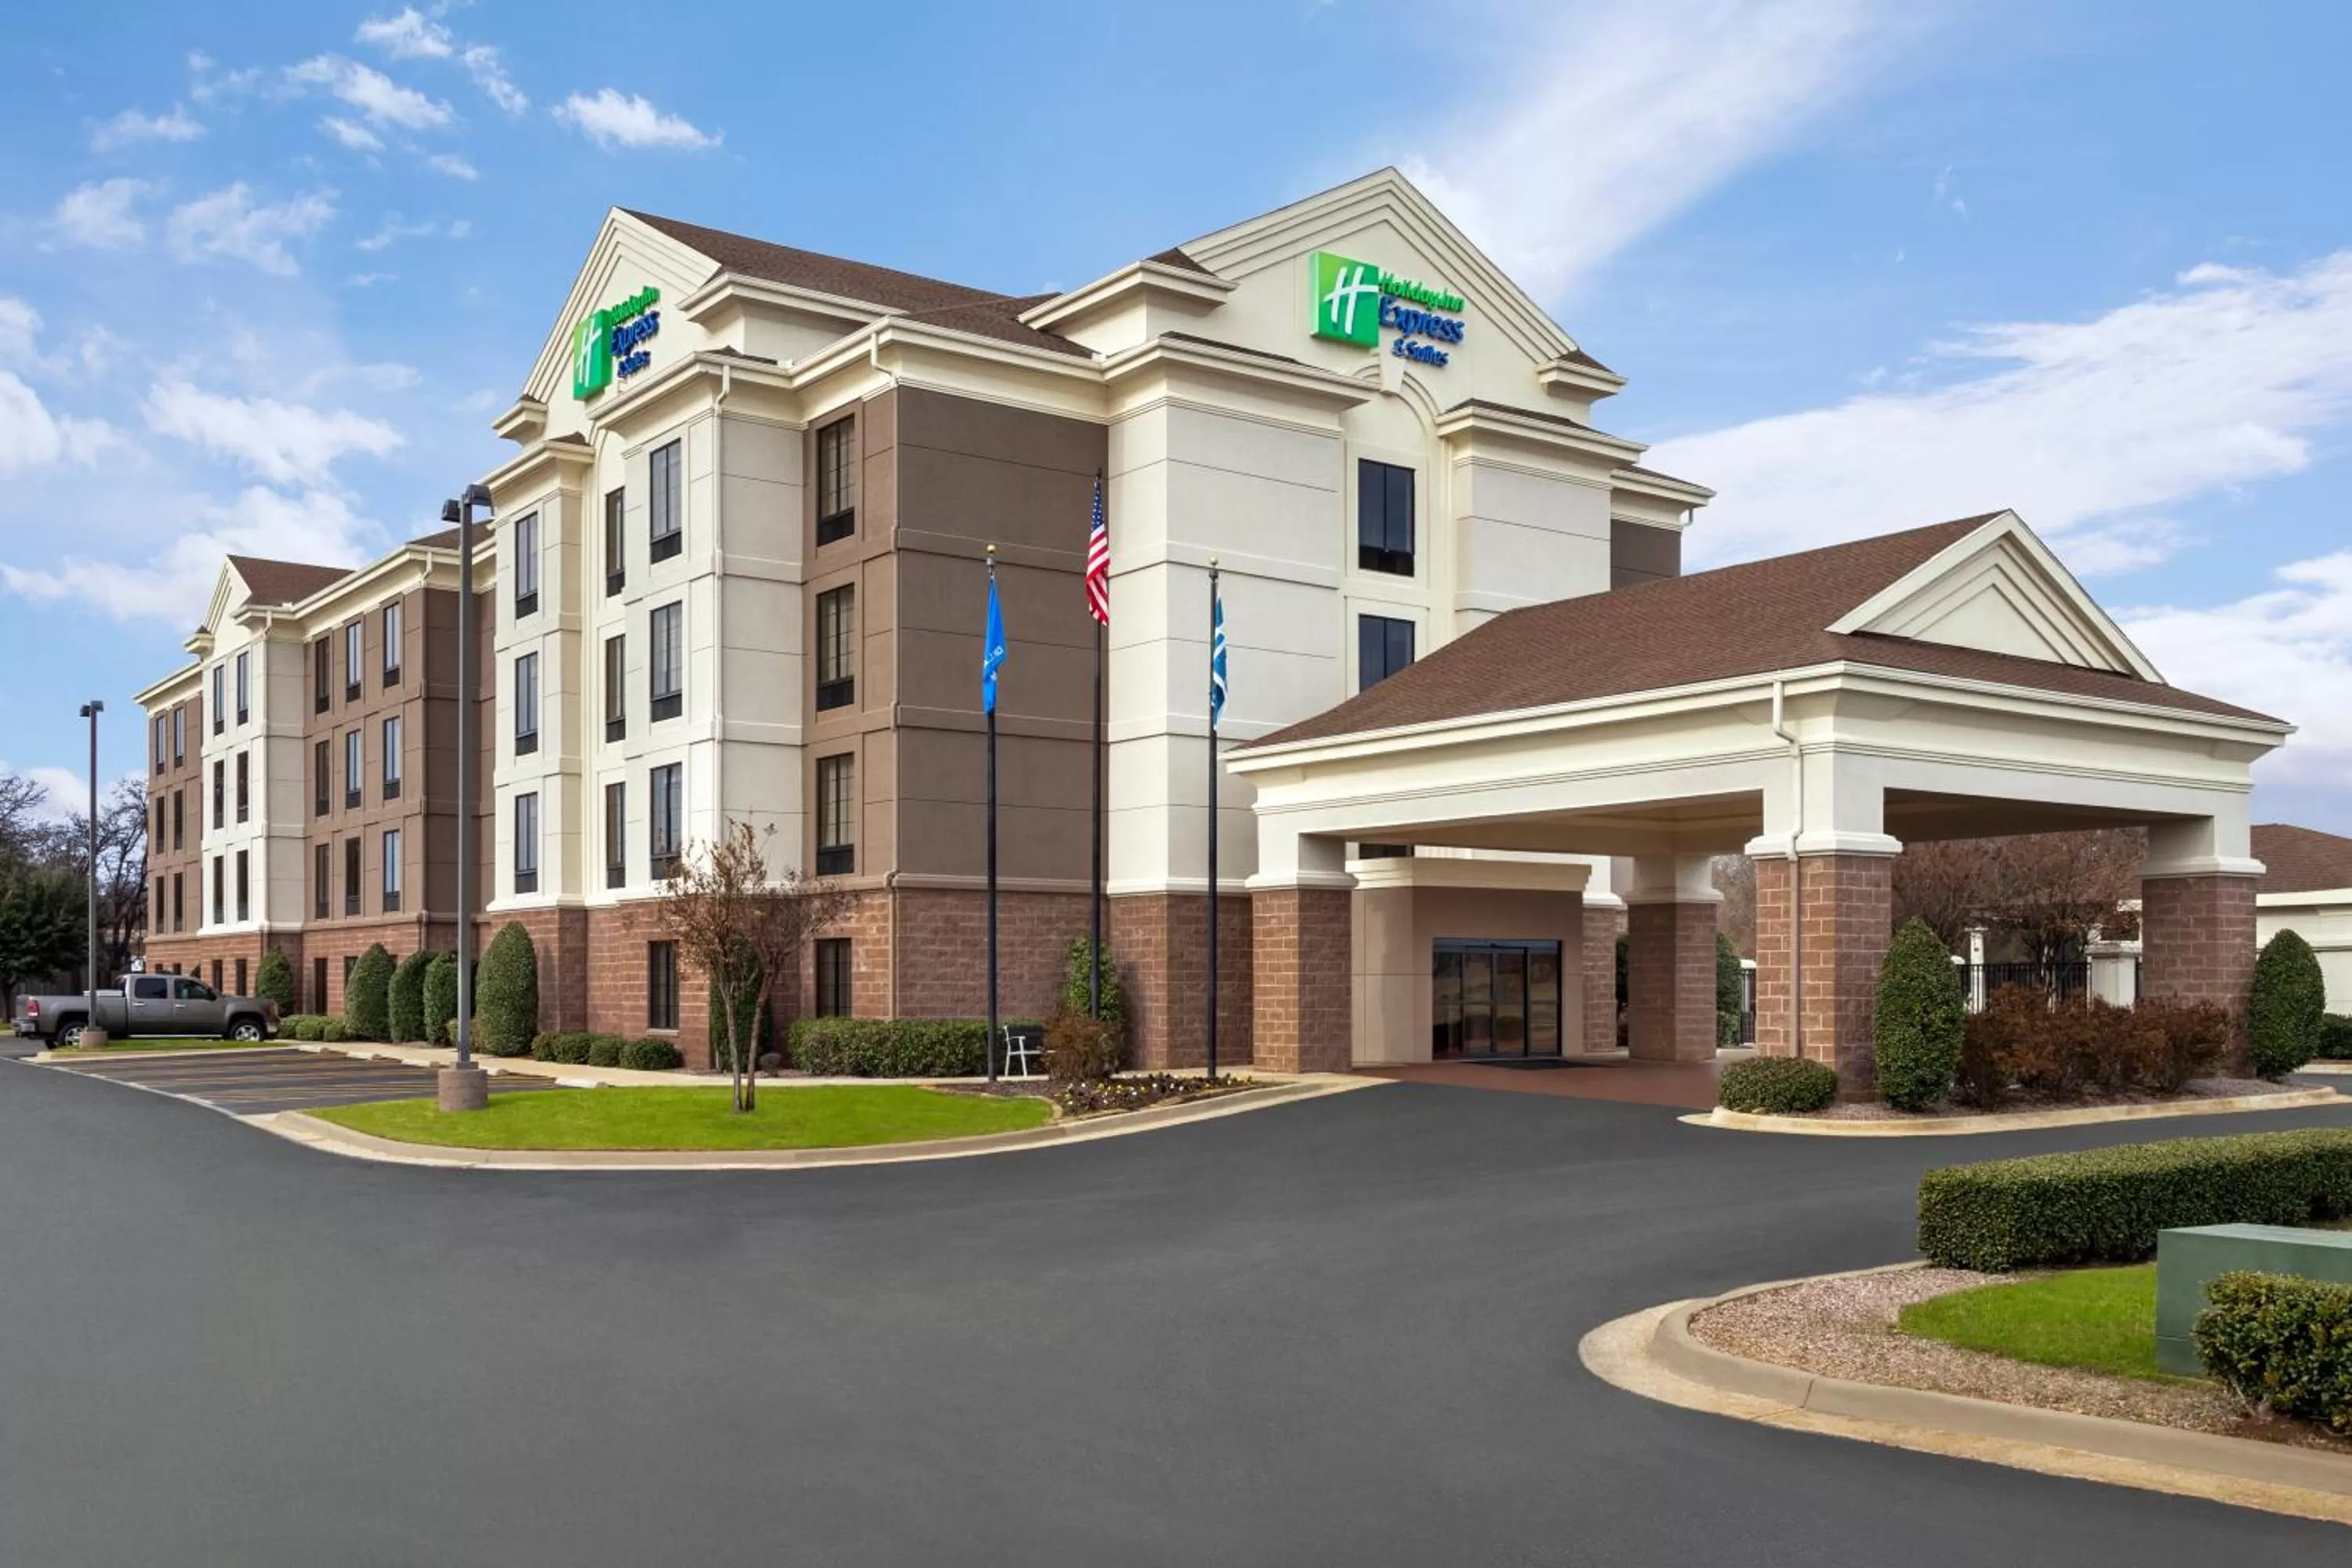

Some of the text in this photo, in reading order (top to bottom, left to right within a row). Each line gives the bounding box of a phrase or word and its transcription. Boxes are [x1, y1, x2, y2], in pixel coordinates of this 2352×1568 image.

[1379, 270, 1465, 314] Holiday Inn
[1379, 294, 1465, 345] Express
[1392, 338, 1450, 368] & Suites
